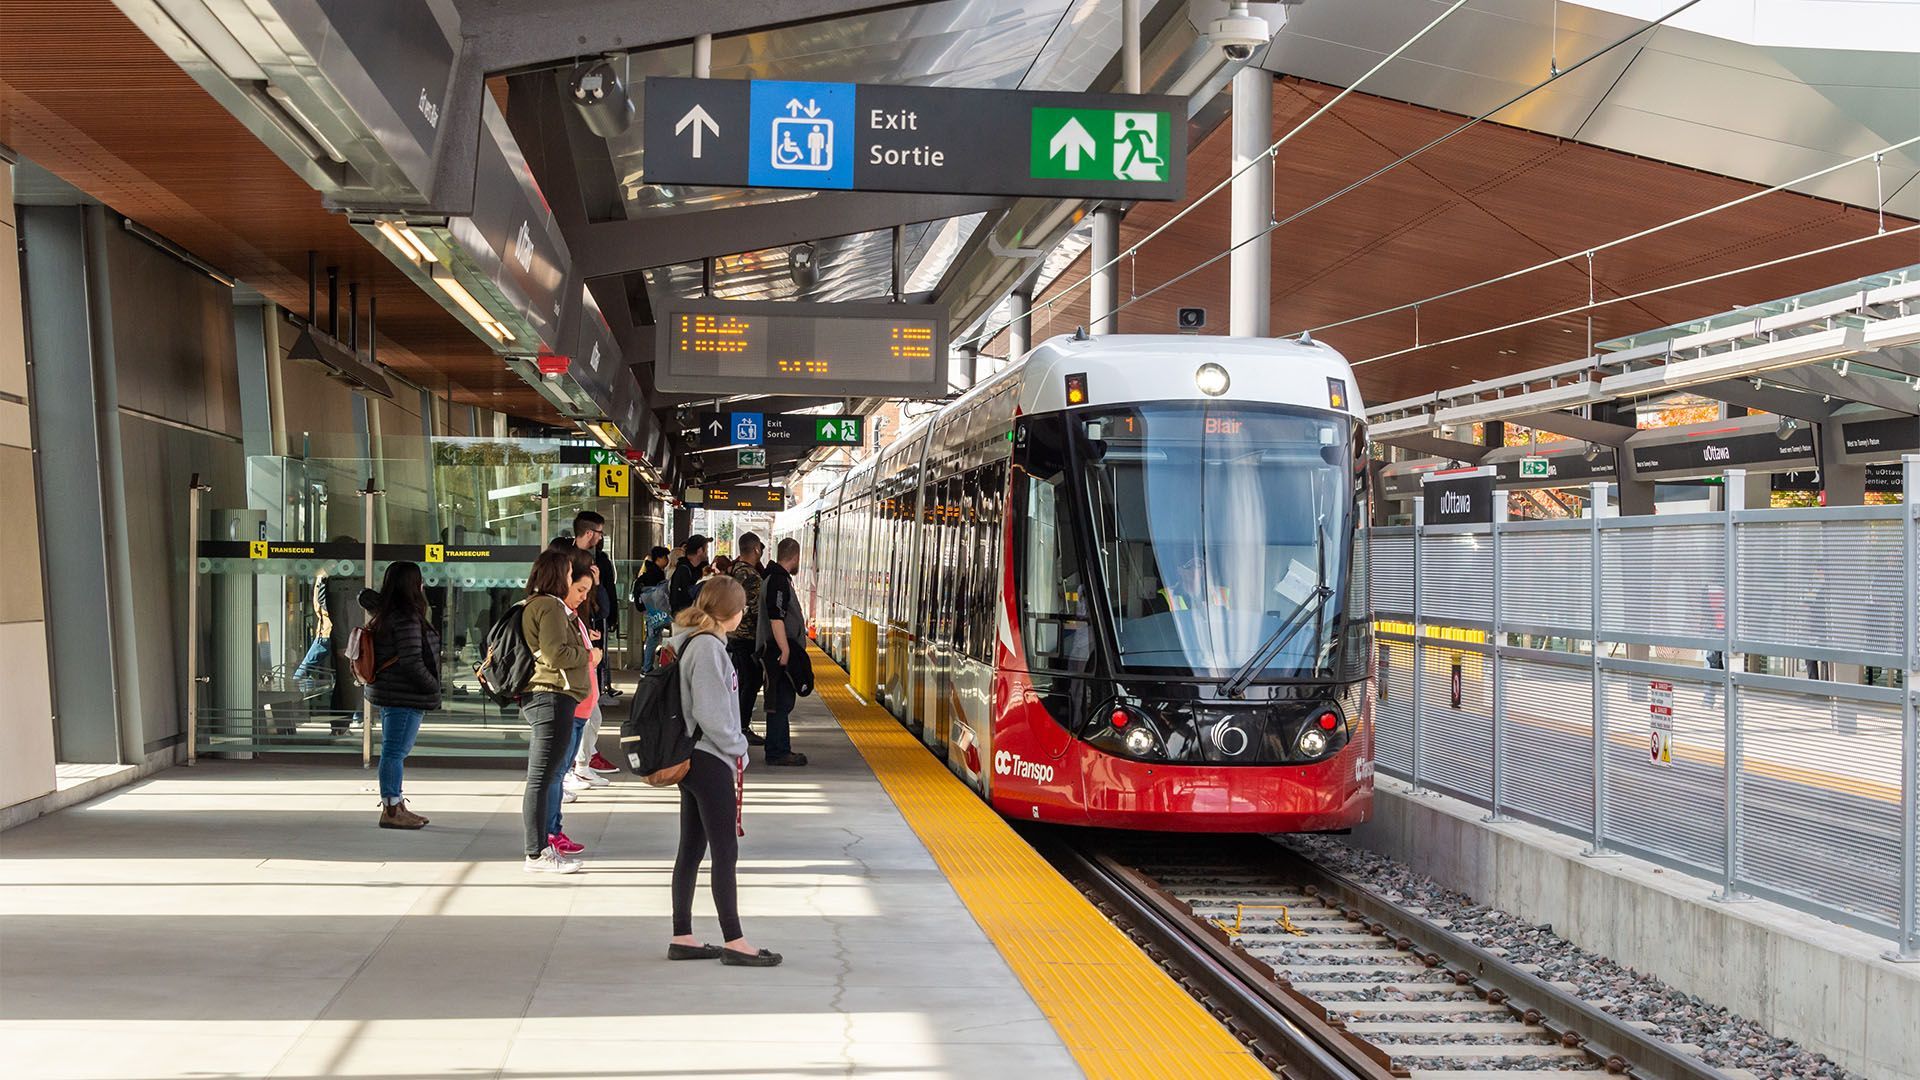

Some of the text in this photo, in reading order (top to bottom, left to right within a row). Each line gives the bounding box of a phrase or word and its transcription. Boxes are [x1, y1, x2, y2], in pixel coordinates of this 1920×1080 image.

[871, 109, 917, 130] Exit
[870, 144, 944, 167] Sortie
[767, 420, 782, 428] Exit
[1125, 416, 1242, 434] 1 Blair
[767, 430, 791, 439] Sortie
[1703, 445, 1730, 461] uOttawa
[1440, 490, 1471, 515] uOttawa
[995, 750, 1054, 785] OC Transpo
